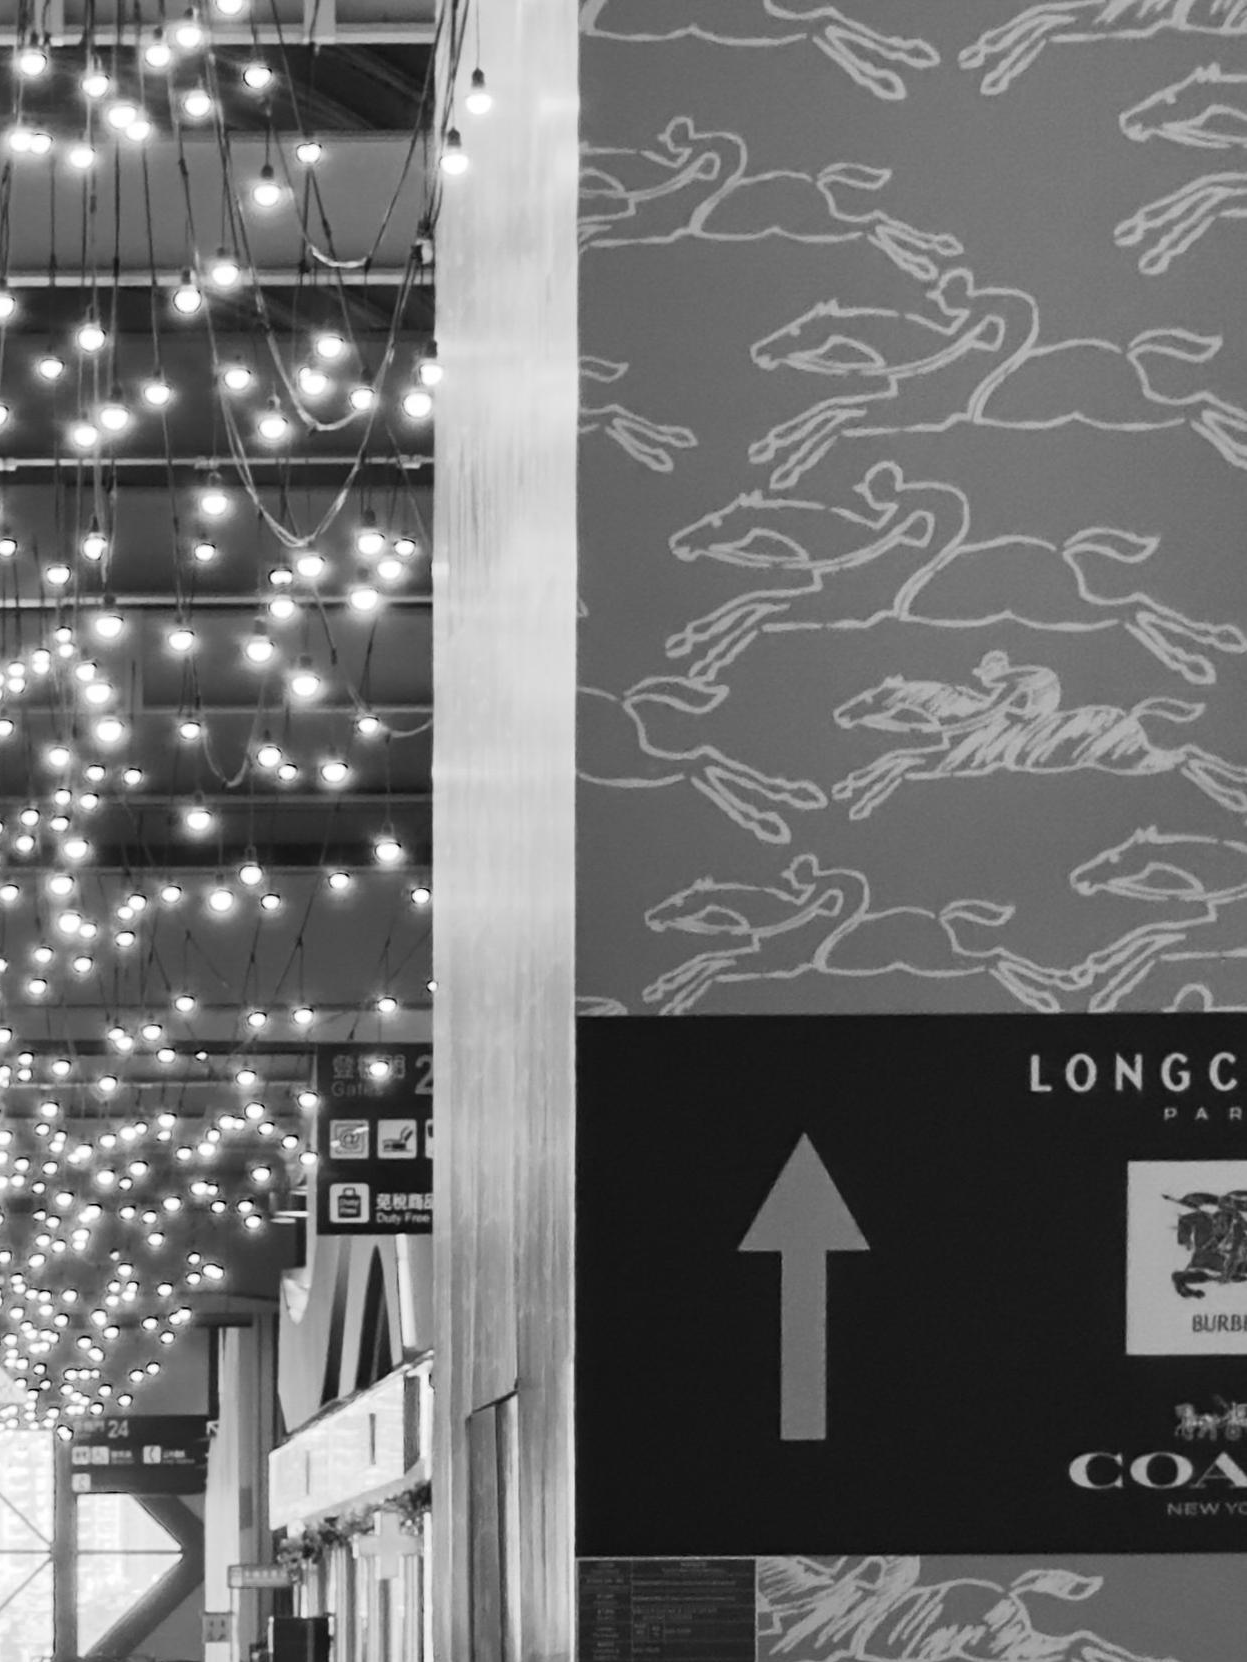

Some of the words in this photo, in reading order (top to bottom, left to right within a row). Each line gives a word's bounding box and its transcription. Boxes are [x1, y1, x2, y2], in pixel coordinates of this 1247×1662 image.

[1029, 1052, 1239, 1093] LONGC
[1163, 1106, 1243, 1121] PAR
[376, 1211, 402, 1226] Duty
[404, 1211, 432, 1224] Free
[107, 1419, 130, 1439] 24
[1067, 1451, 1247, 1490] COA
[1166, 1501, 1221, 1516] NEW
